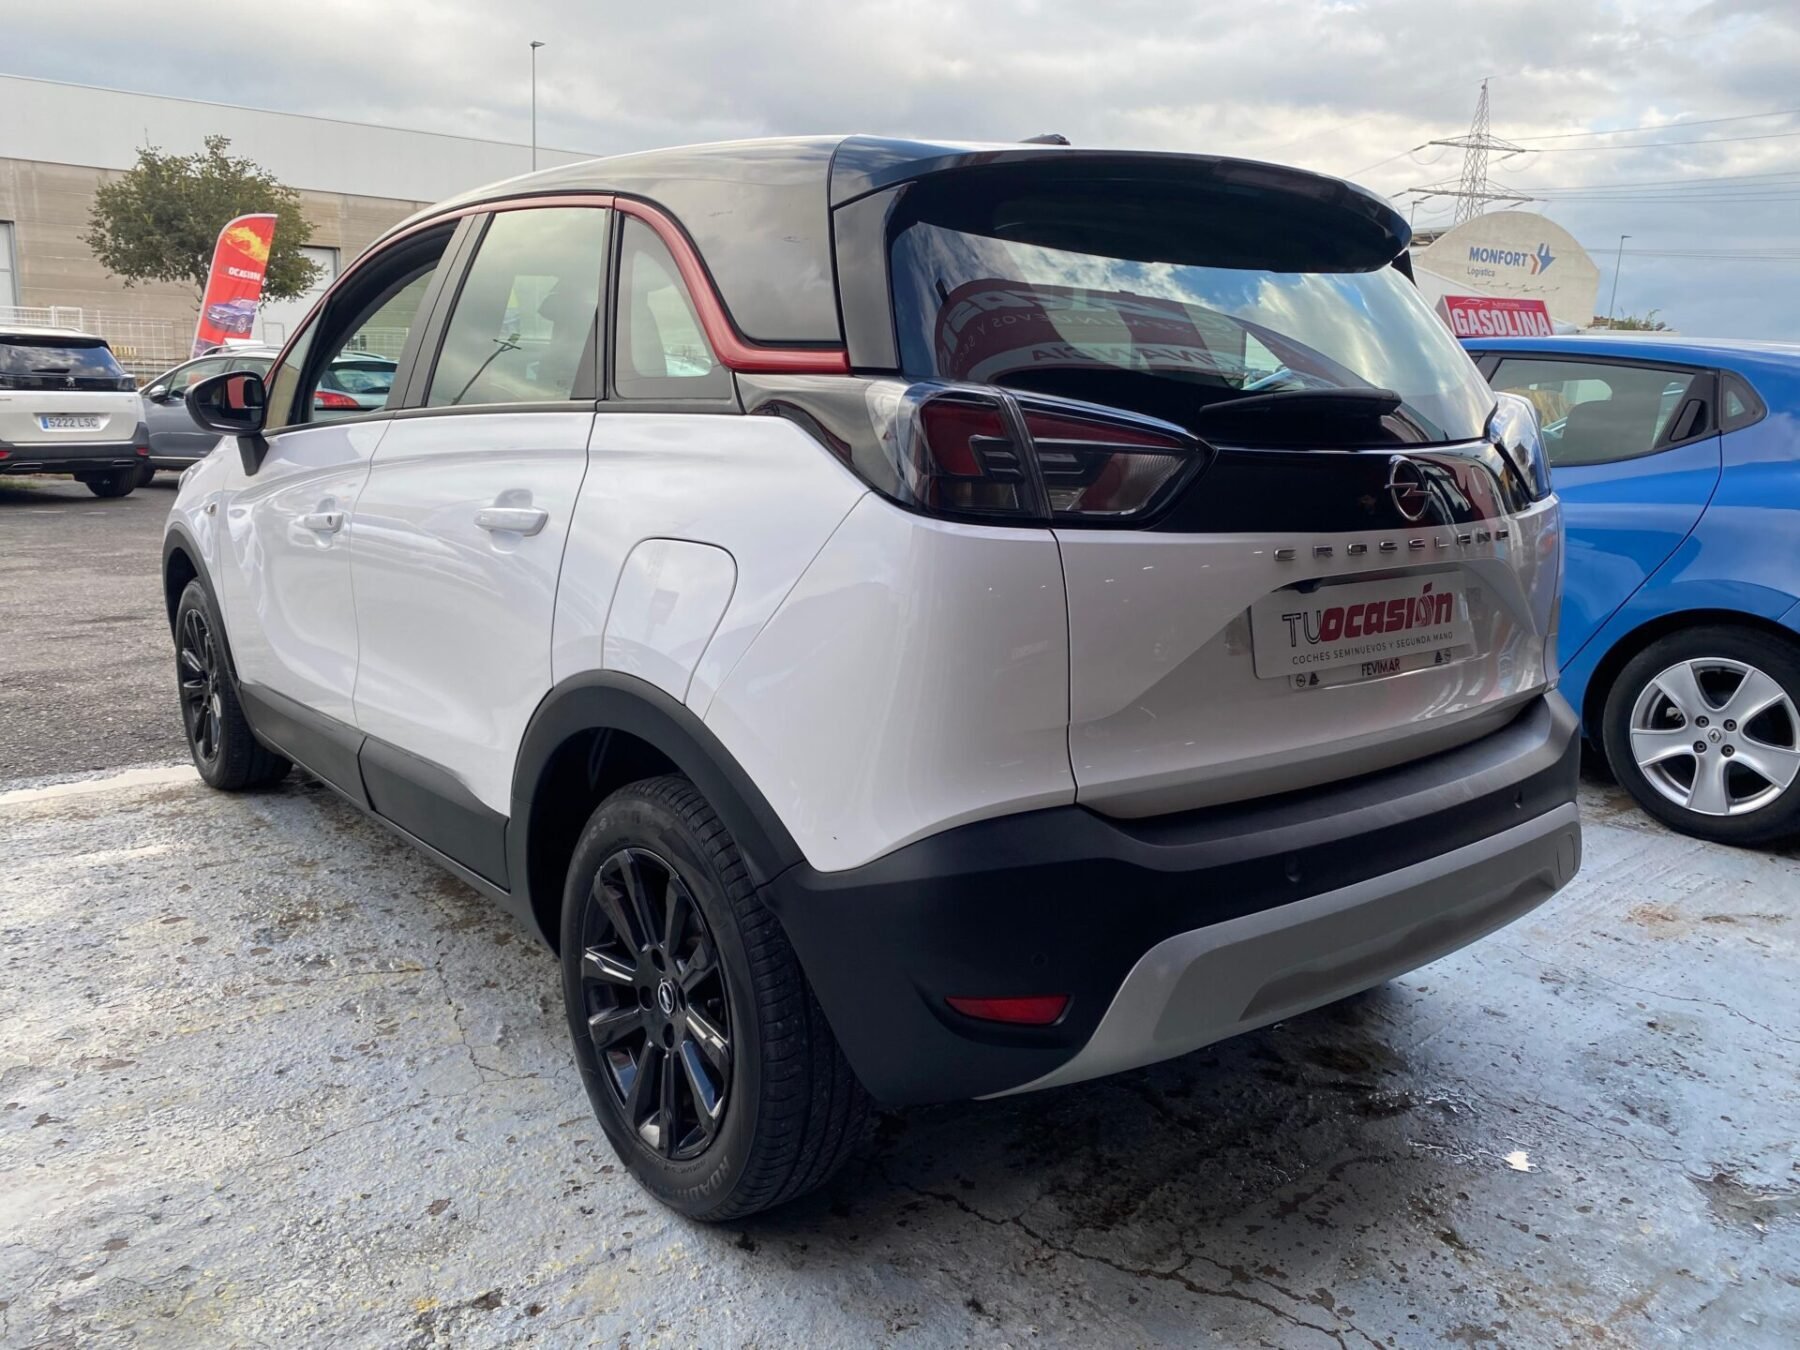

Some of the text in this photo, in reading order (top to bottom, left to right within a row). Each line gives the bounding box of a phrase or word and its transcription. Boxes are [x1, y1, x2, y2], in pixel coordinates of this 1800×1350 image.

[1469, 246, 1528, 267] MONFORT
[1451, 307, 1552, 337] GASOLINA
[48, 417, 98, 428] 5222 LSC
[1273, 529, 1510, 562] CROSSLAND
[1292, 652, 1331, 666] COCHES
[1333, 641, 1387, 659] SEMINUEVOS
[1396, 635, 1432, 649] SEGUNDA
[1433, 631, 1454, 642] MANO
[1361, 658, 1401, 677] FEVIMAR
